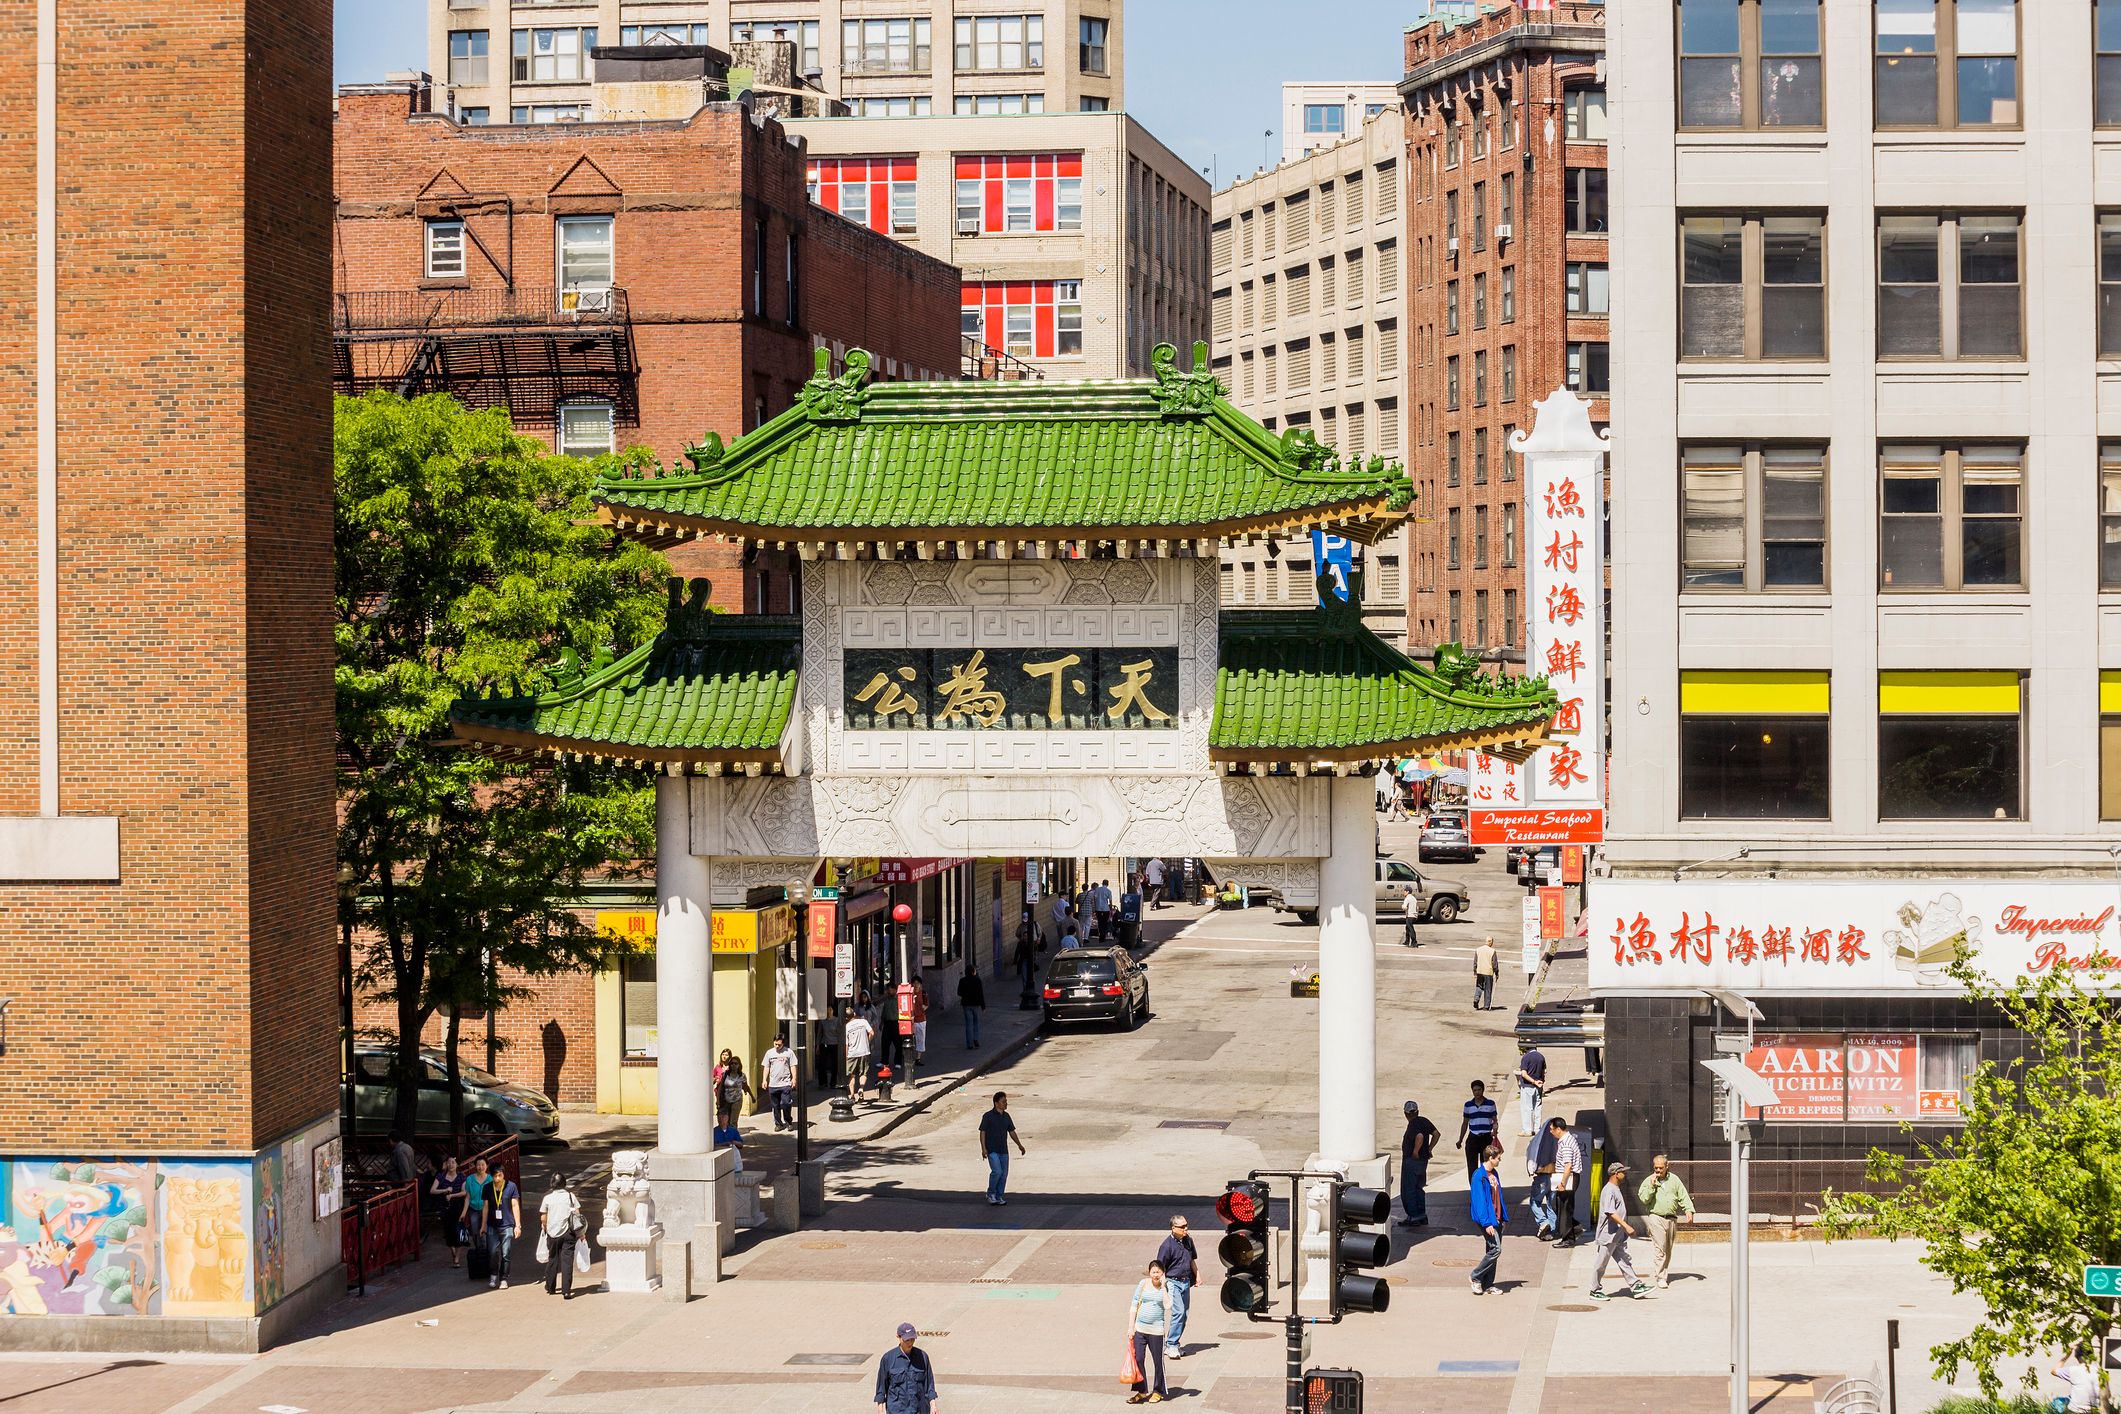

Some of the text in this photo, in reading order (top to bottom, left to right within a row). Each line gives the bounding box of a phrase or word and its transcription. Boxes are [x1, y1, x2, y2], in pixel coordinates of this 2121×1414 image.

[1321, 532, 1347, 602] PA
[1543, 477, 1588, 788] 漁村海鮮酒家
[1482, 812, 1593, 828] Imperial Seafood
[1505, 828, 1570, 842] Restaurant
[1995, 905, 2115, 942] Imperial
[712, 938, 750, 949] STRY
[1610, 911, 1872, 967] 漁村海鮮酒家
[1868, 1038, 1879, 1046] 19,
[1758, 1048, 1903, 1073] AARON
